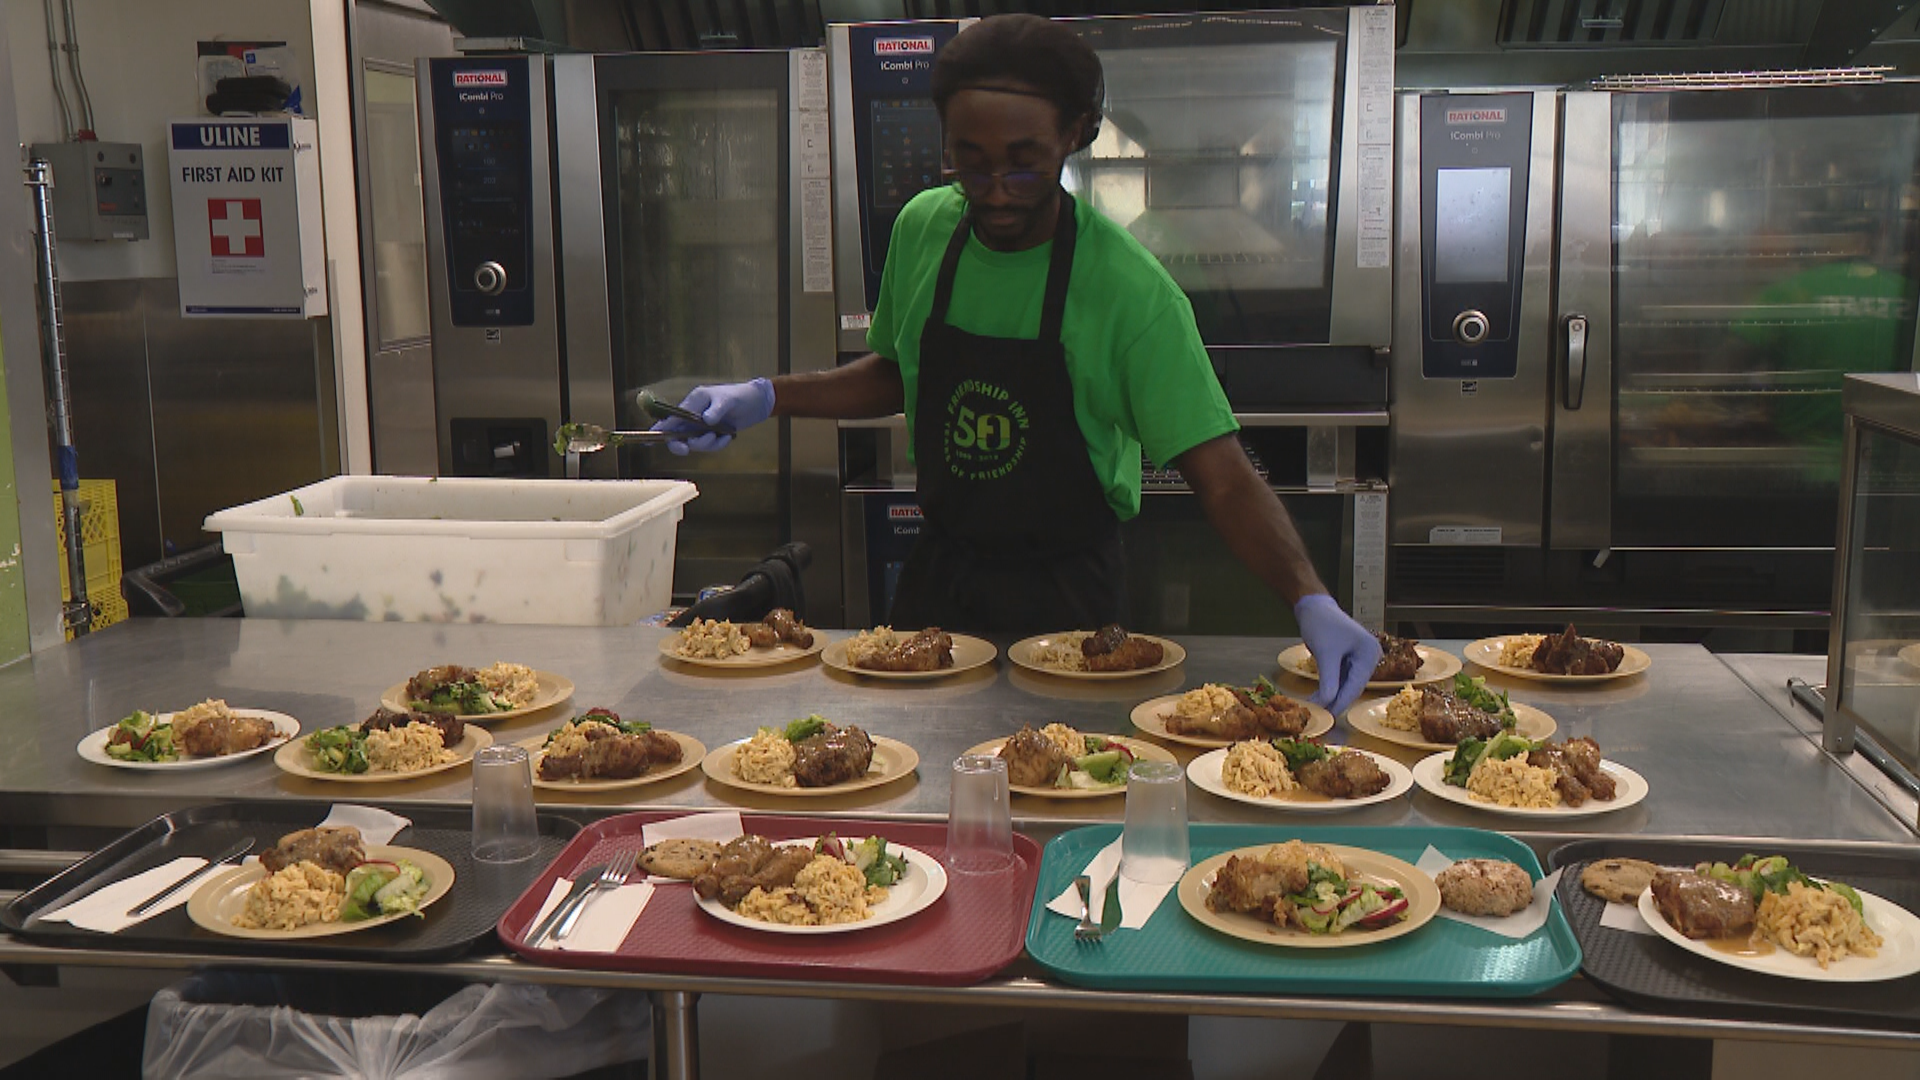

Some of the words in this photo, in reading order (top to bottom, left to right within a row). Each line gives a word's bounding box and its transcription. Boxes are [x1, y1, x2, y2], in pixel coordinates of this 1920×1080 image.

[878, 41, 930, 51] RATIONAL
[881, 60, 913, 71] iCombi
[915, 60, 930, 70] Pro
[456, 74, 504, 83] RATIONAL
[459, 91, 489, 101] iCombi
[490, 92, 504, 101] Pro
[1449, 111, 1503, 121] RATIONAL
[200, 126, 261, 147] ULINE
[1450, 130, 1484, 140] iCombi
[1485, 131, 1501, 140] Pro
[182, 167, 222, 182] FIRST
[227, 167, 256, 182] AID
[261, 167, 284, 182] KIT
[1008, 401, 1030, 429] INN
